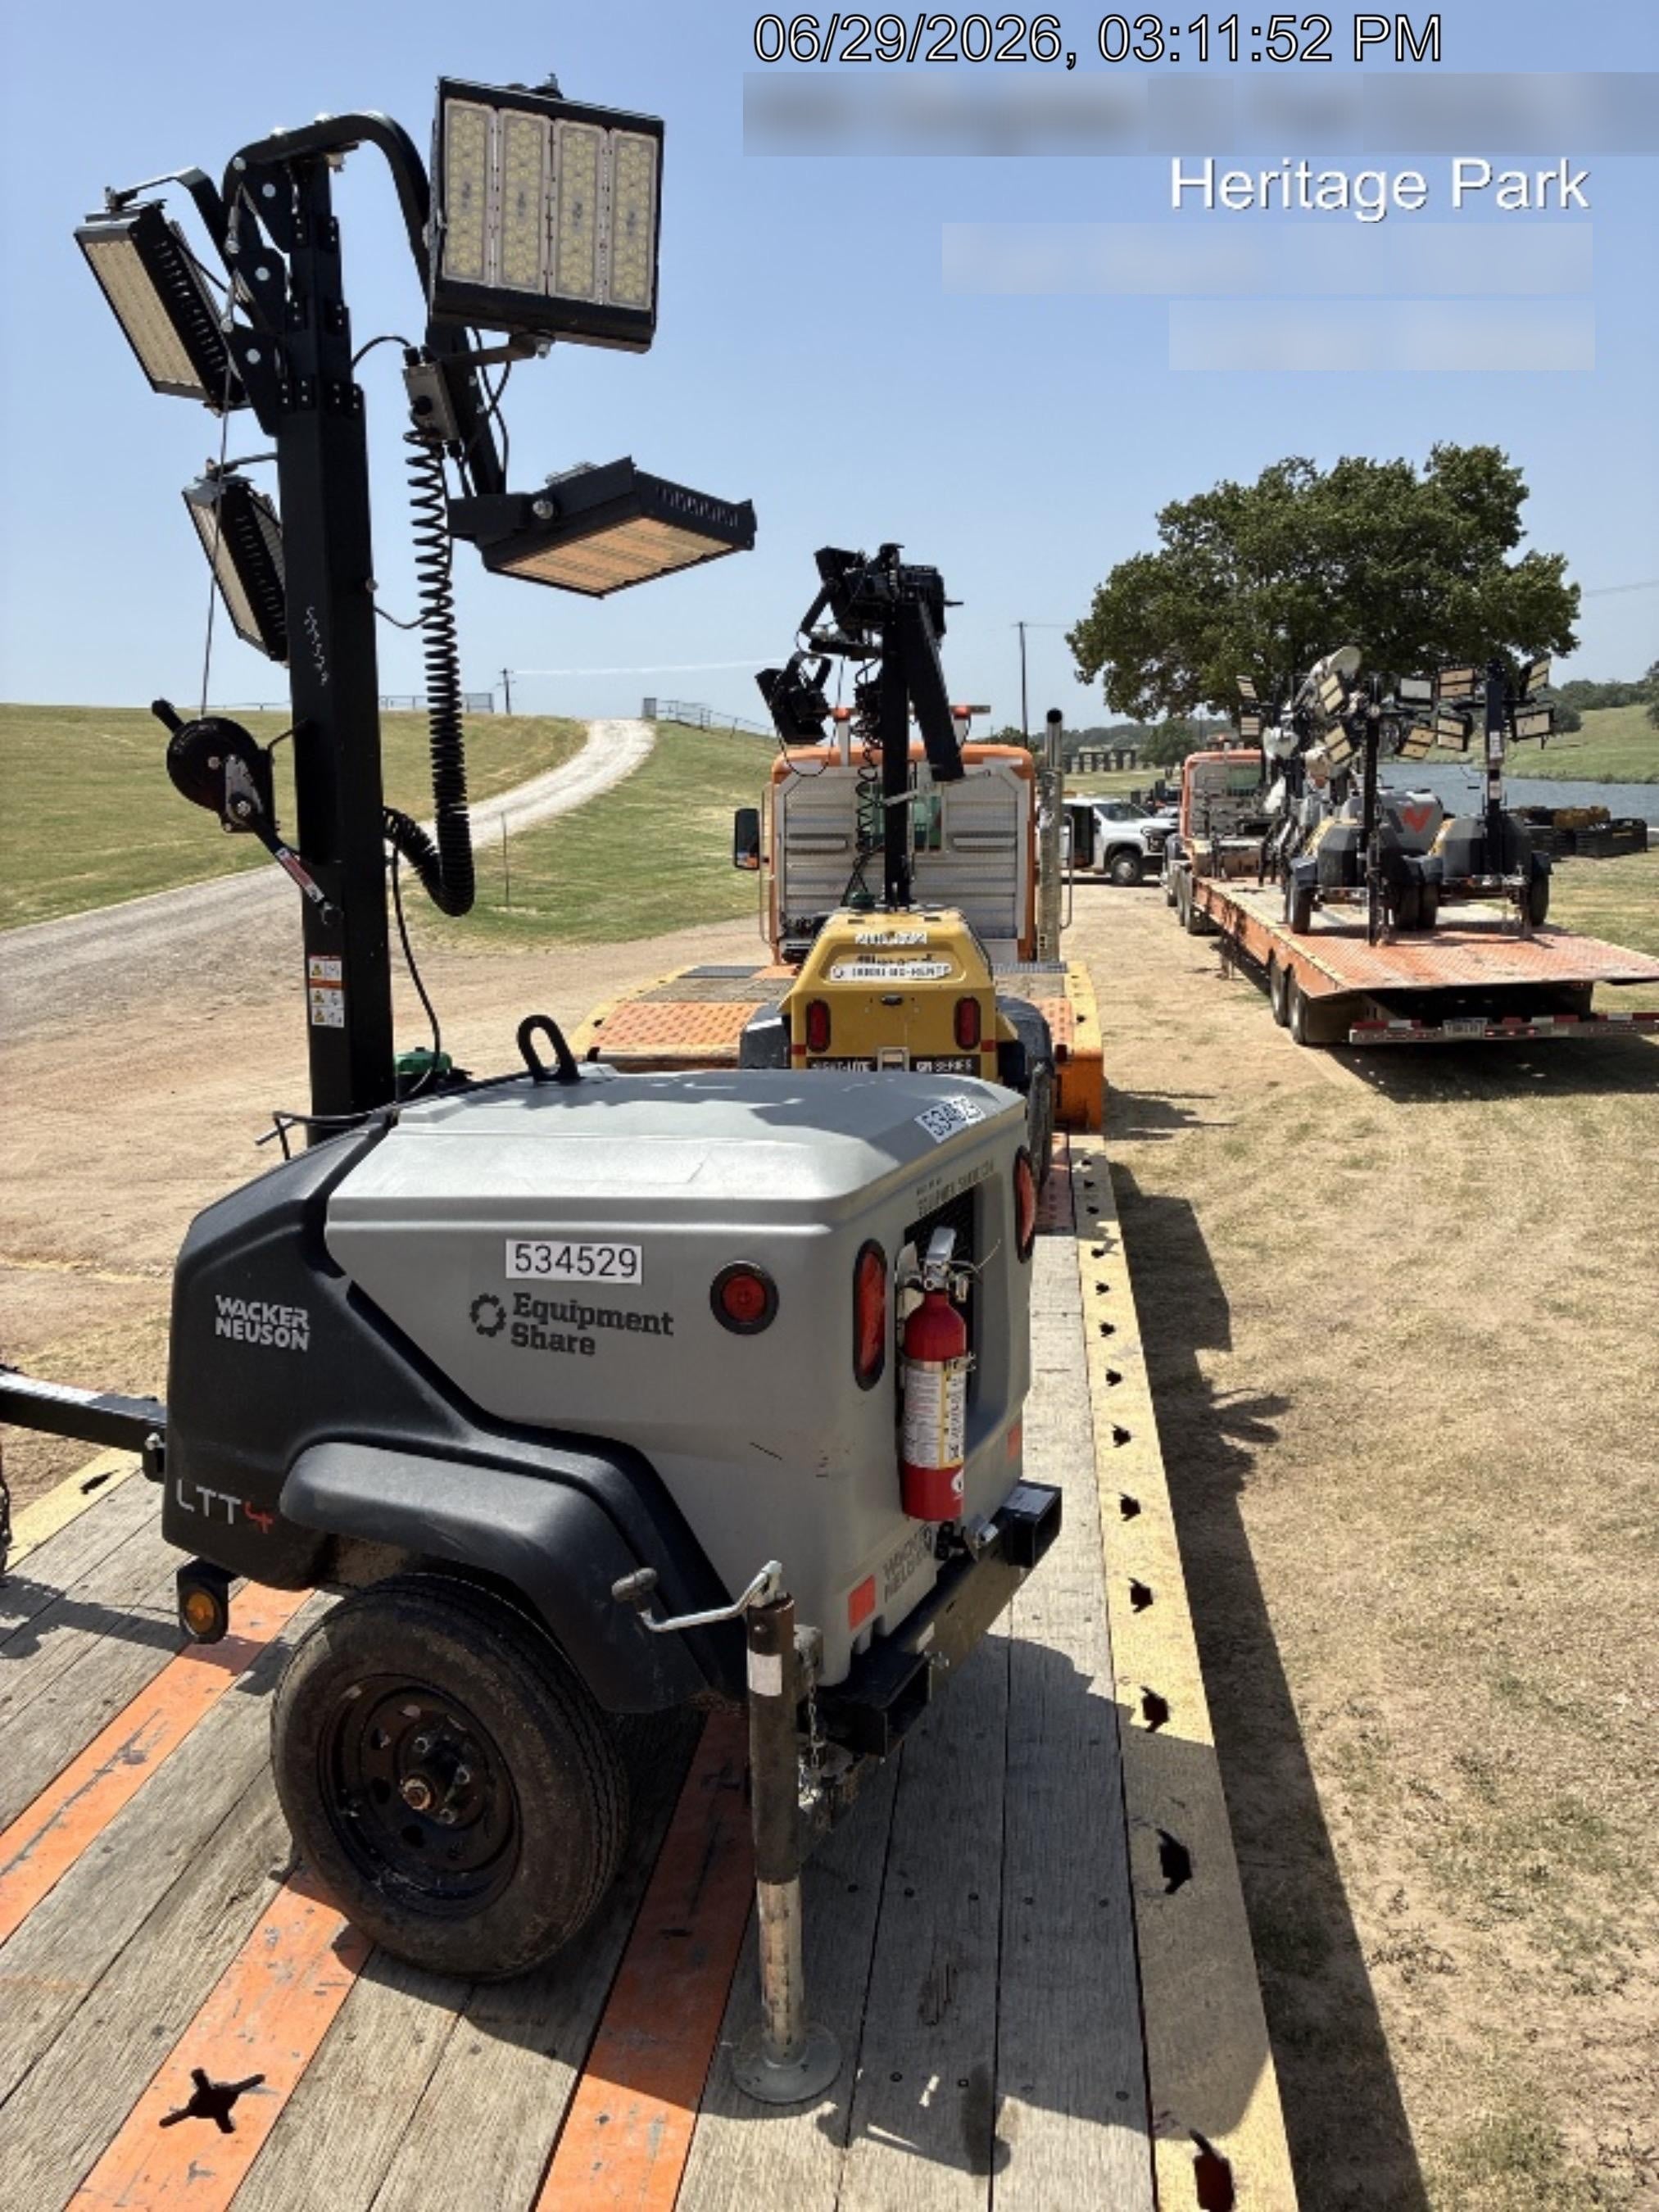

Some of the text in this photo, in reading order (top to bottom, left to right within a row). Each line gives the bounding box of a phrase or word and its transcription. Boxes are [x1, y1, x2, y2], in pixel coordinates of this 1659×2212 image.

[514, 1244, 637, 1278] 534529
[215, 1294, 310, 1331] WACKER
[512, 1292, 674, 1337] Equipment
[215, 1320, 310, 1352] NEUSON
[510, 1322, 596, 1357] Share
[175, 1478, 274, 1534] LTT4
